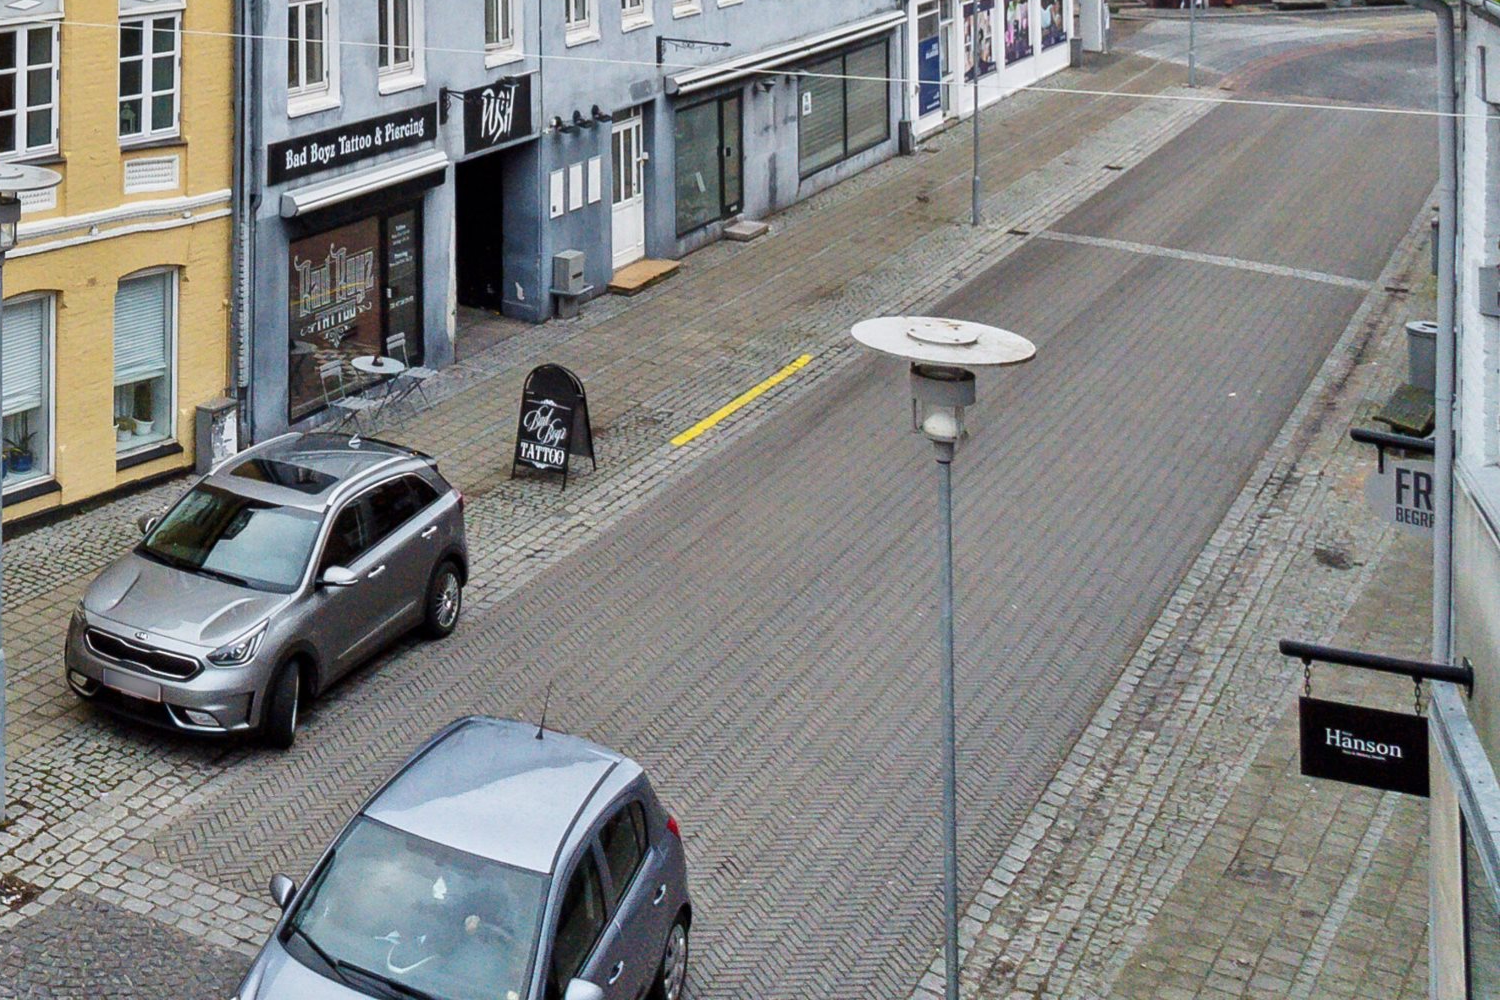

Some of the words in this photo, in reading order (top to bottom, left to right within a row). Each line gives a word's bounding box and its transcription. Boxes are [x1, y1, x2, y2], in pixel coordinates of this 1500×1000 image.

[285, 149, 307, 170] Bad
[310, 142, 336, 164] Boyz
[338, 132, 372, 156] Tattoo
[374, 126, 382, 146] &
[385, 117, 424, 143] Piercing
[294, 255, 330, 318] Bad
[330, 243, 374, 304] Boyz
[524, 405, 554, 432] Bad
[520, 442, 565, 465] TATTOO
